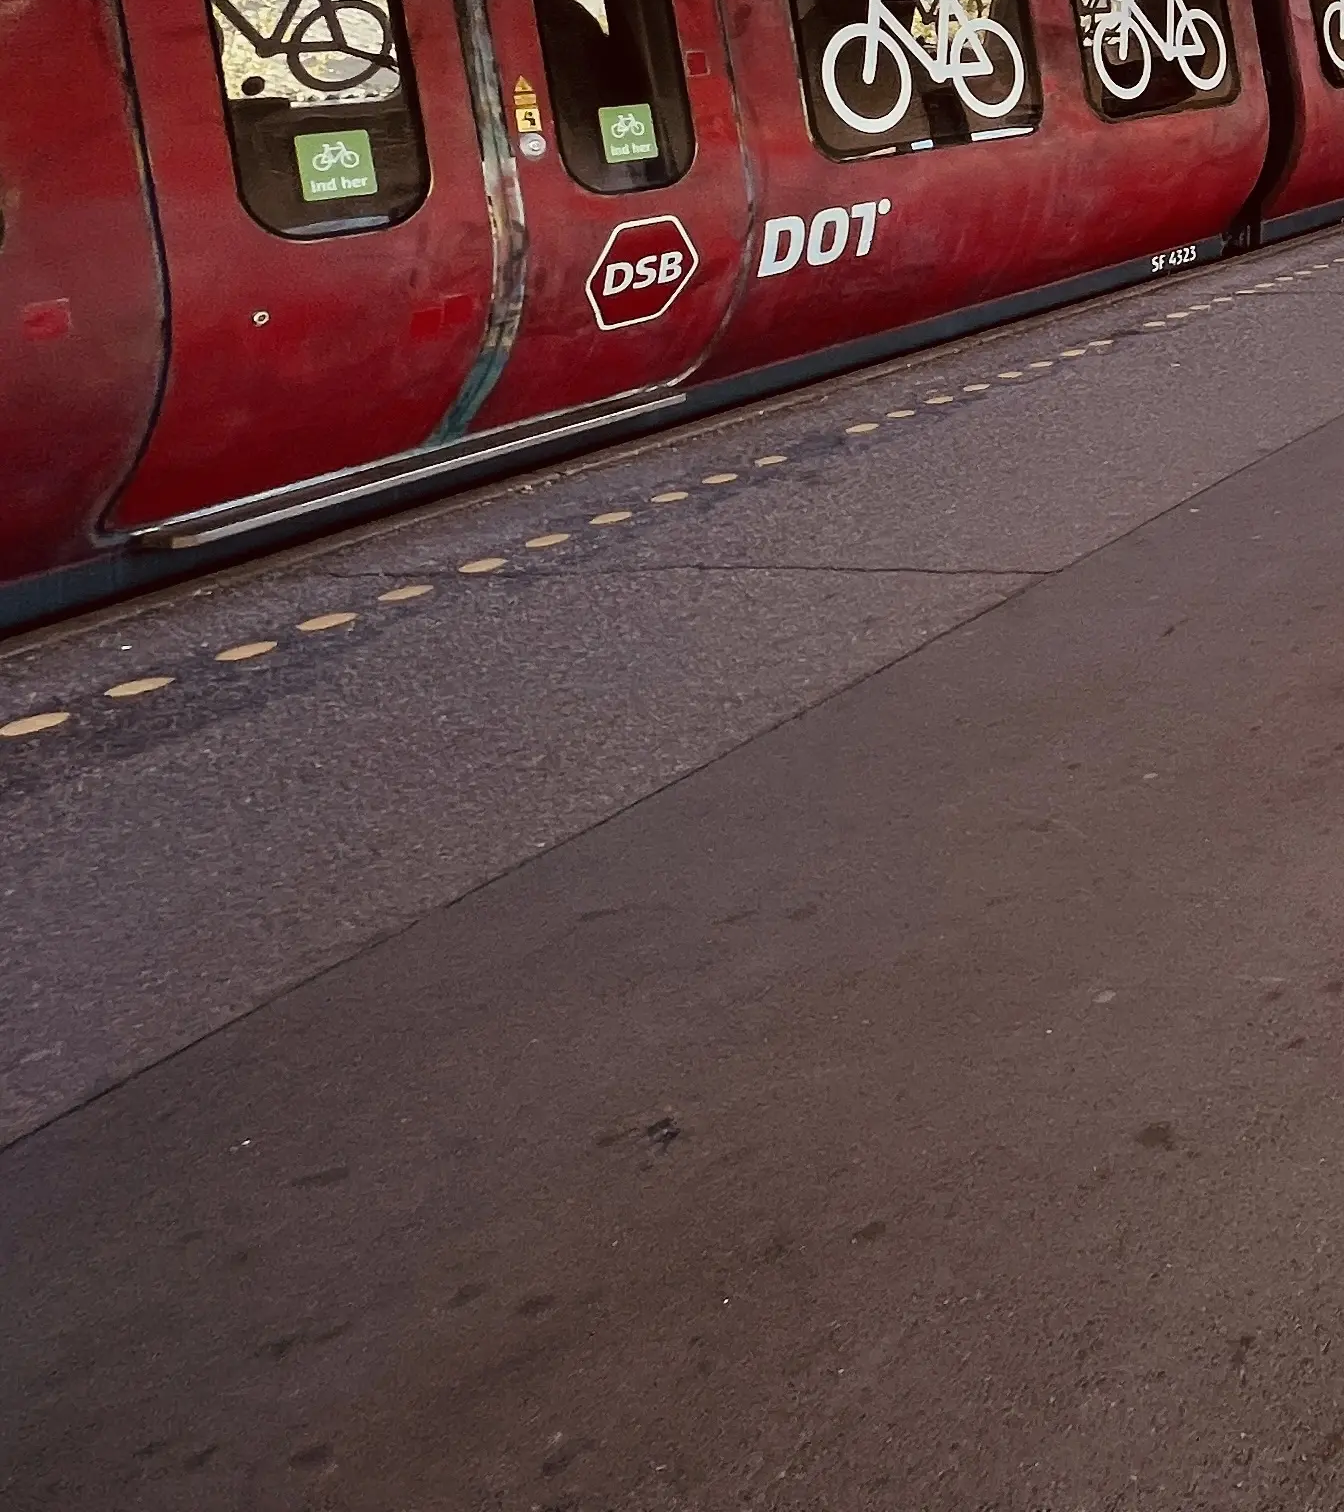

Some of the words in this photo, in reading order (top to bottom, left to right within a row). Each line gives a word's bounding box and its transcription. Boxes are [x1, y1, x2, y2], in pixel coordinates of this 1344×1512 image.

[610, 143, 630, 156] Ind
[632, 142, 651, 154] her
[310, 177, 338, 194] Ind
[340, 175, 369, 189] her
[756, 198, 891, 278] DOT
[602, 250, 684, 296] DSB
[1151, 254, 1167, 273] SF
[1168, 245, 1197, 266] 4323
